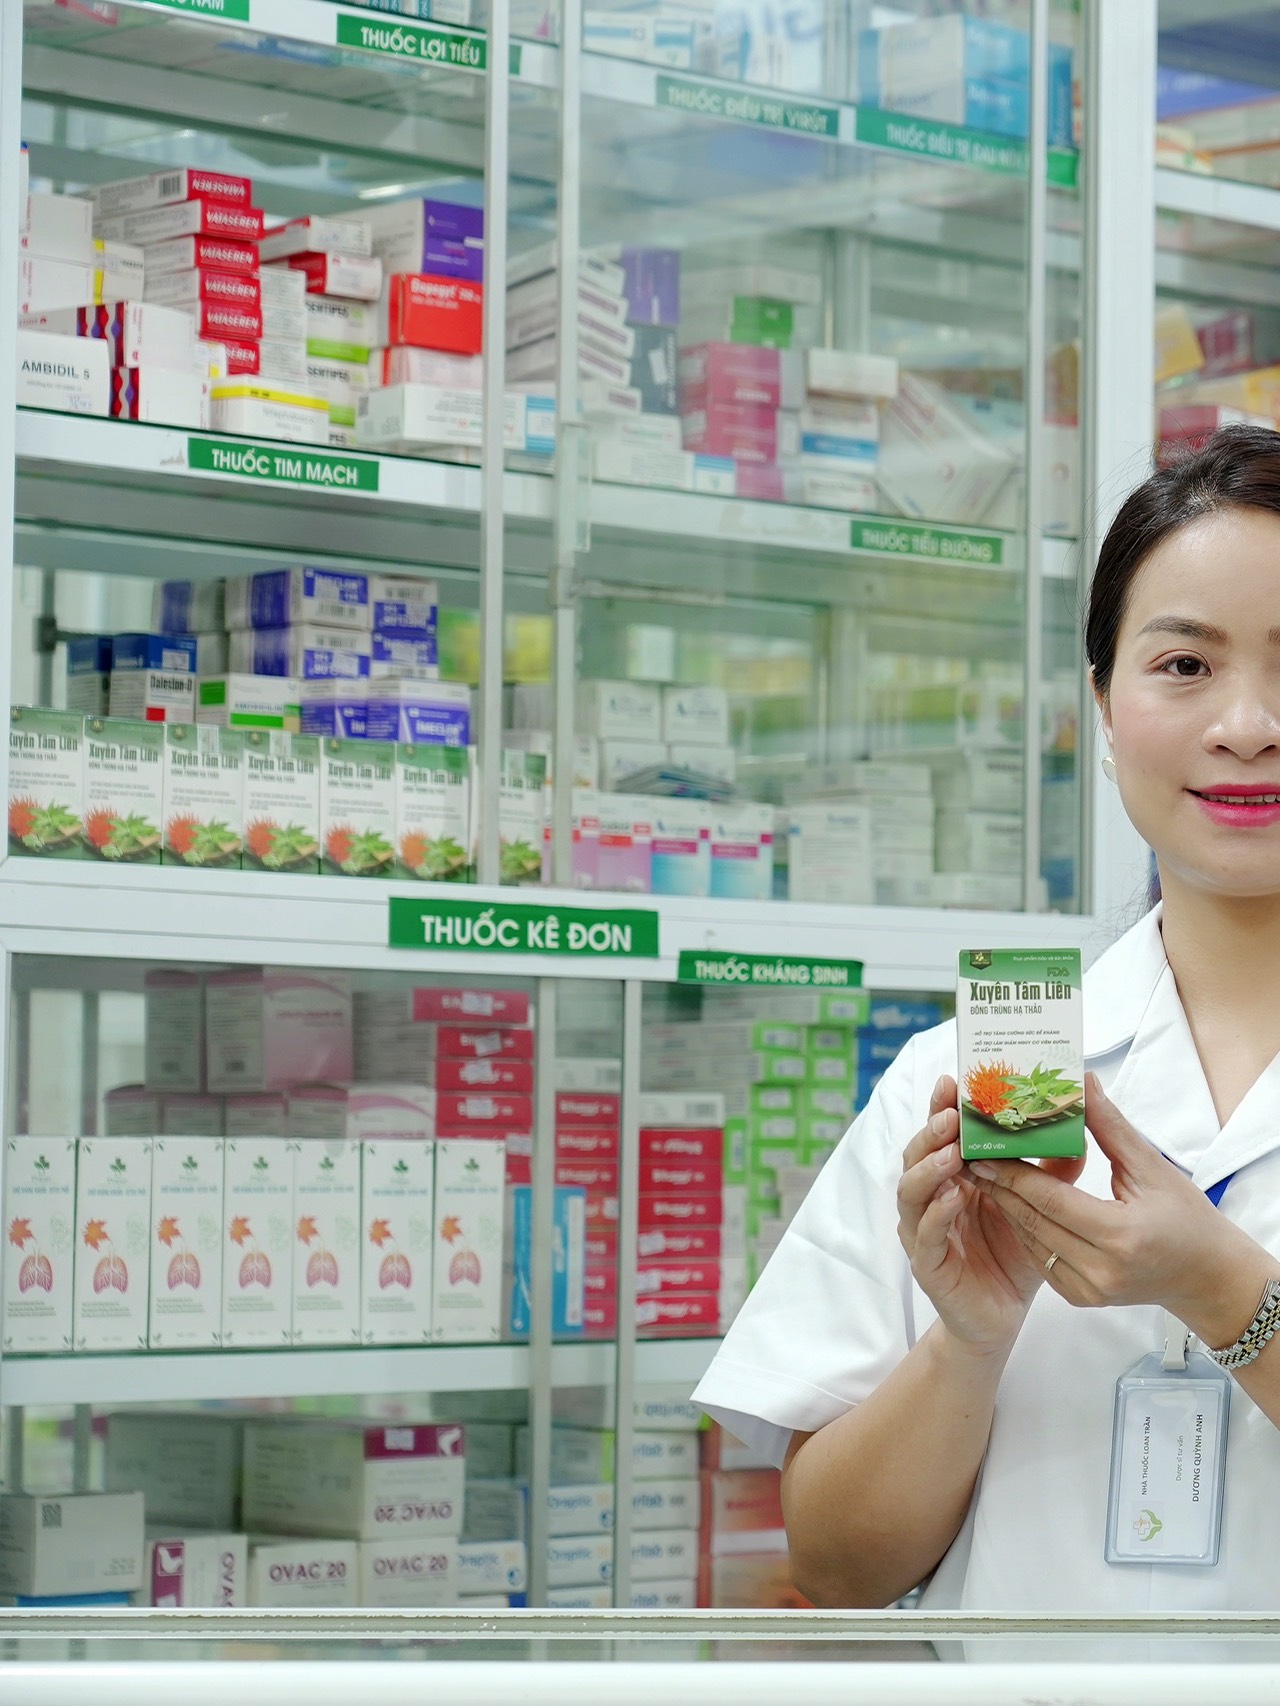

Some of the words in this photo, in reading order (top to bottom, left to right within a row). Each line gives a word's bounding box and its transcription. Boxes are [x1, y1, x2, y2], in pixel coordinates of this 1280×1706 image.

[361, 26, 417, 53] THUỐC
[420, 36, 446, 61] LỢI
[450, 37, 480, 65] TIỂU
[21, 360, 79, 378] AMBIDIL
[211, 447, 270, 476] THUỐC
[275, 457, 302, 479] TIM
[306, 461, 358, 486] MẠCH
[861, 528, 910, 551] THUỐC
[420, 908, 521, 947] THUỐC
[527, 914, 560, 949] KÊ
[566, 922, 632, 953] ĐƠN
[694, 956, 750, 982] THUỐC
[752, 959, 811, 985] KHÁNG
[812, 965, 848, 985] SINH
[1046, 966, 1071, 977] FDA
[970, 981, 1010, 1004] Xuyên
[1014, 980, 1041, 1001] Tâm
[1045, 980, 1072, 1000] Liên
[970, 1004, 989, 1015] ĐÔNG
[990, 1004, 1012, 1015] TRÙNG
[1013, 1005, 1023, 1016] HẠ
[1025, 1003, 1043, 1014] THẢO
[983, 1142, 992, 1150] 60
[992, 1142, 1006, 1150] VIÊN
[1143, 1416, 1151, 1435] TRẦN
[1143, 1436, 1151, 1455] LOAN
[1192, 1435, 1202, 1466] QUỲNH
[1141, 1456, 1149, 1479] THUỐC
[1175, 1464, 1183, 1482] Dược
[1192, 1468, 1200, 1502] DƯƠNG
[373, 1504, 395, 1523] 20
[400, 1503, 452, 1522] OVAC
[269, 1559, 321, 1582] OVAC
[327, 1560, 347, 1579] 20
[373, 1555, 424, 1576] OVAC
[429, 1554, 449, 1572] 20
